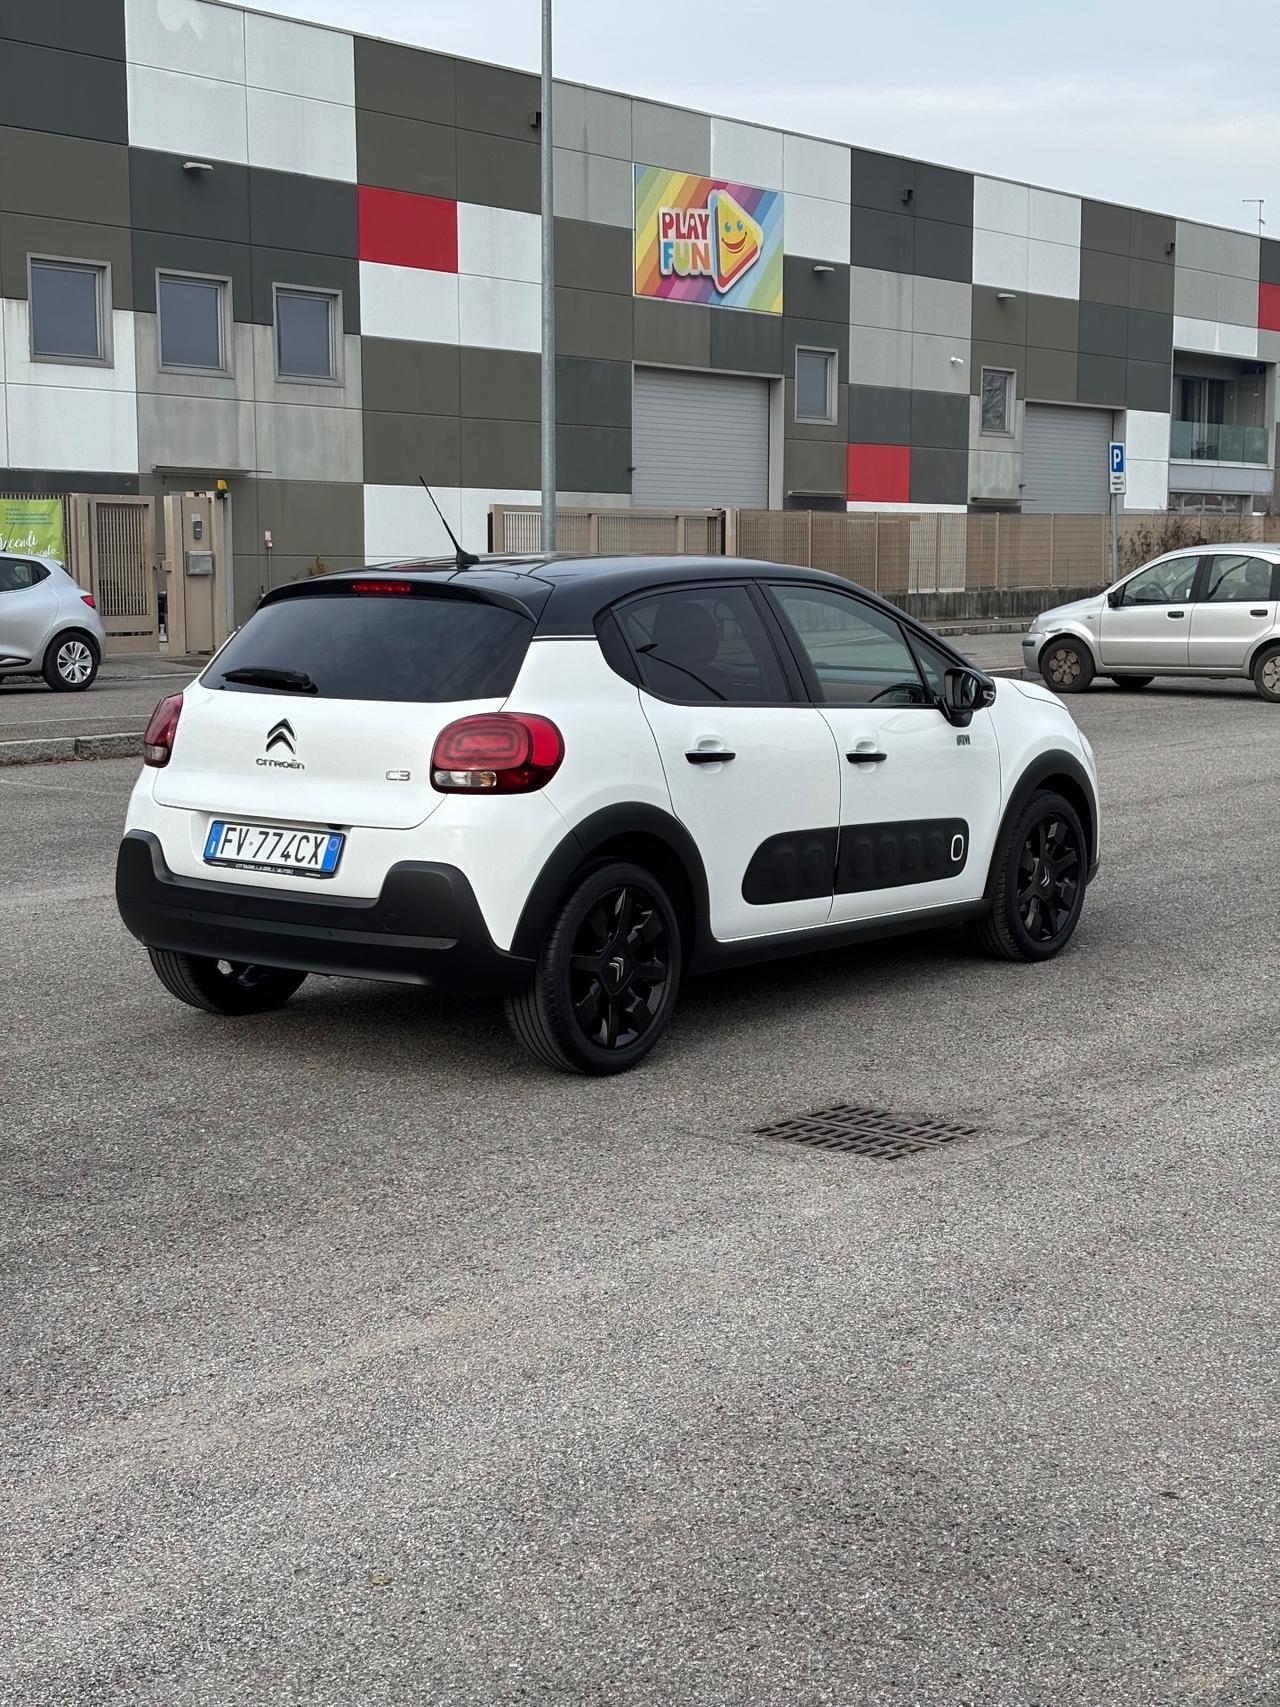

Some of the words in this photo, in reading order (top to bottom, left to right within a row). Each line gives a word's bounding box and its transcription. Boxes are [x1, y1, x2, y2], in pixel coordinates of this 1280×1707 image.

[661, 212, 710, 240] PLAY
[662, 241, 711, 273] FUN
[1113, 449, 1121, 470] P
[385, 770, 411, 782] C3
